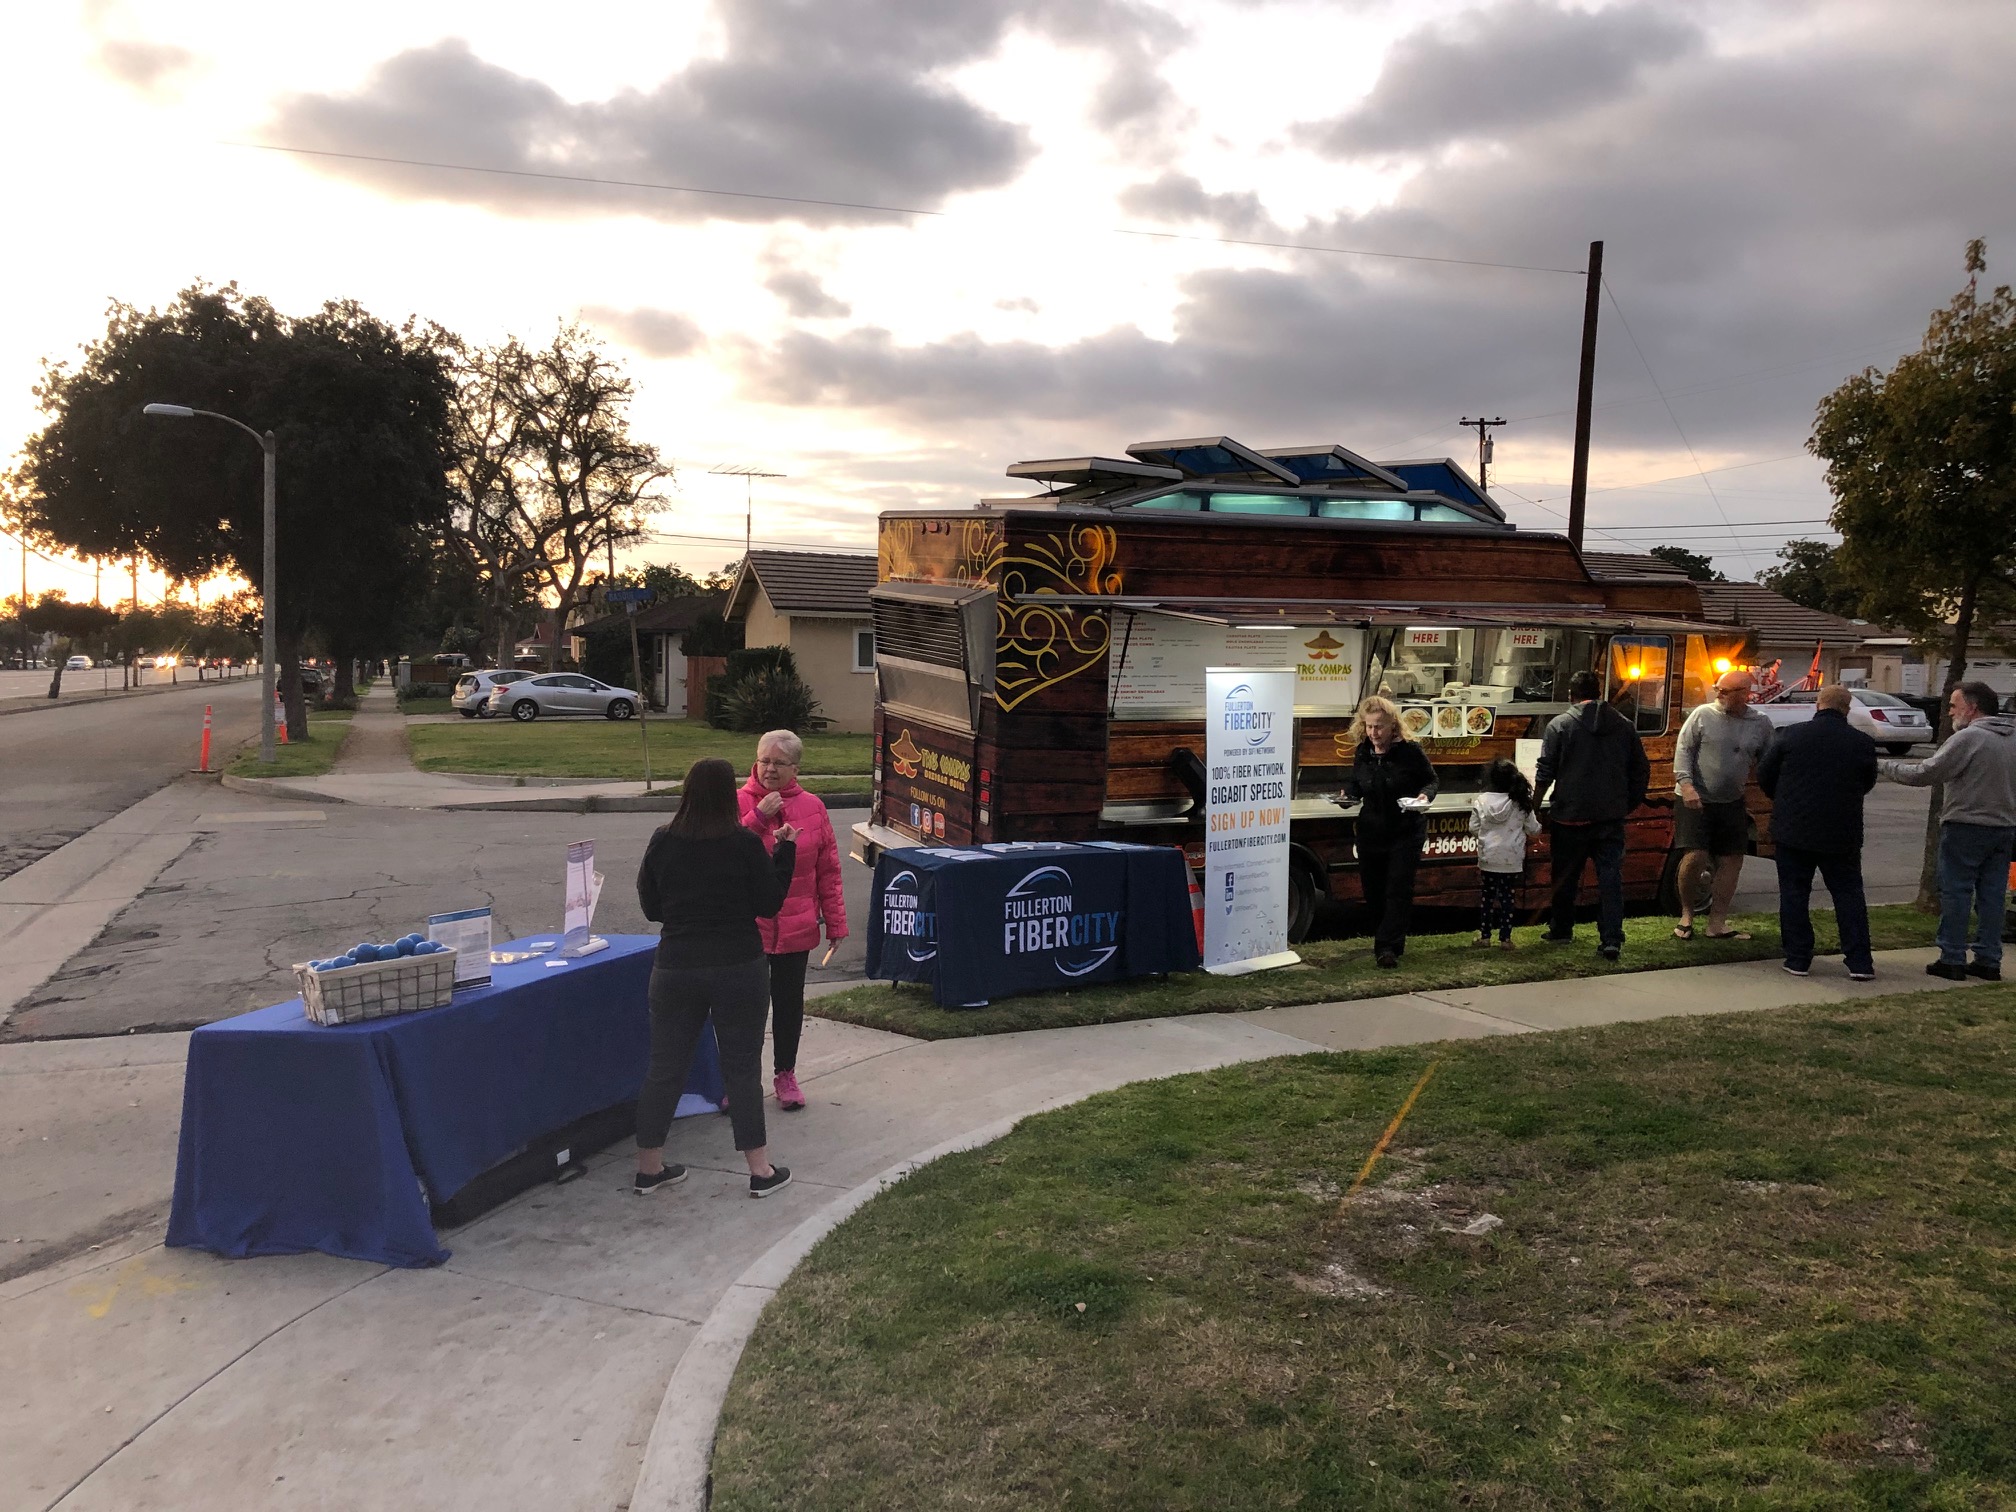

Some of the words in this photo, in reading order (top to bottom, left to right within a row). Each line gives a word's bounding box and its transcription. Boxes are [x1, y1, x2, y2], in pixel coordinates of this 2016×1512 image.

[1413, 633, 1439, 643] HERE
[1513, 634, 1538, 645] HERE
[1296, 664, 1316, 675] TRES
[1319, 663, 1352, 675] COMPAS
[1225, 701, 1253, 711] FULLERTON
[1224, 712, 1272, 730] FIBERCITY
[1224, 749, 1241, 757] POWERED
[1242, 748, 1248, 756] BY
[1256, 746, 1276, 755] NETWORKS
[921, 748, 939, 772] TRES
[939, 754, 971, 783] COMPAS
[1212, 766, 1230, 780] 100%
[1232, 765, 1251, 779] FIBER
[1253, 763, 1286, 777] NETWORK.
[949, 778, 966, 792] GRILL
[1211, 785, 1247, 805] GIGABIT
[1250, 781, 1285, 801] SPEEDS.
[910, 786, 929, 803] FOLLOW
[929, 793, 937, 806] US
[937, 796, 946, 809] ON
[1211, 812, 1236, 832] SIGN
[1241, 810, 1255, 828] UP
[1259, 807, 1285, 826] NOW!
[1427, 819, 1437, 833] LL
[1440, 818, 1470, 834] OCASS
[1209, 833, 1287, 852] FULLERTONFIBERCITY.COM
[884, 893, 918, 909] FULLERTON
[1005, 895, 1072, 920] FULLERTON
[883, 909, 936, 938] FIBERCIT
[1004, 911, 1120, 955] FIBERCITY
